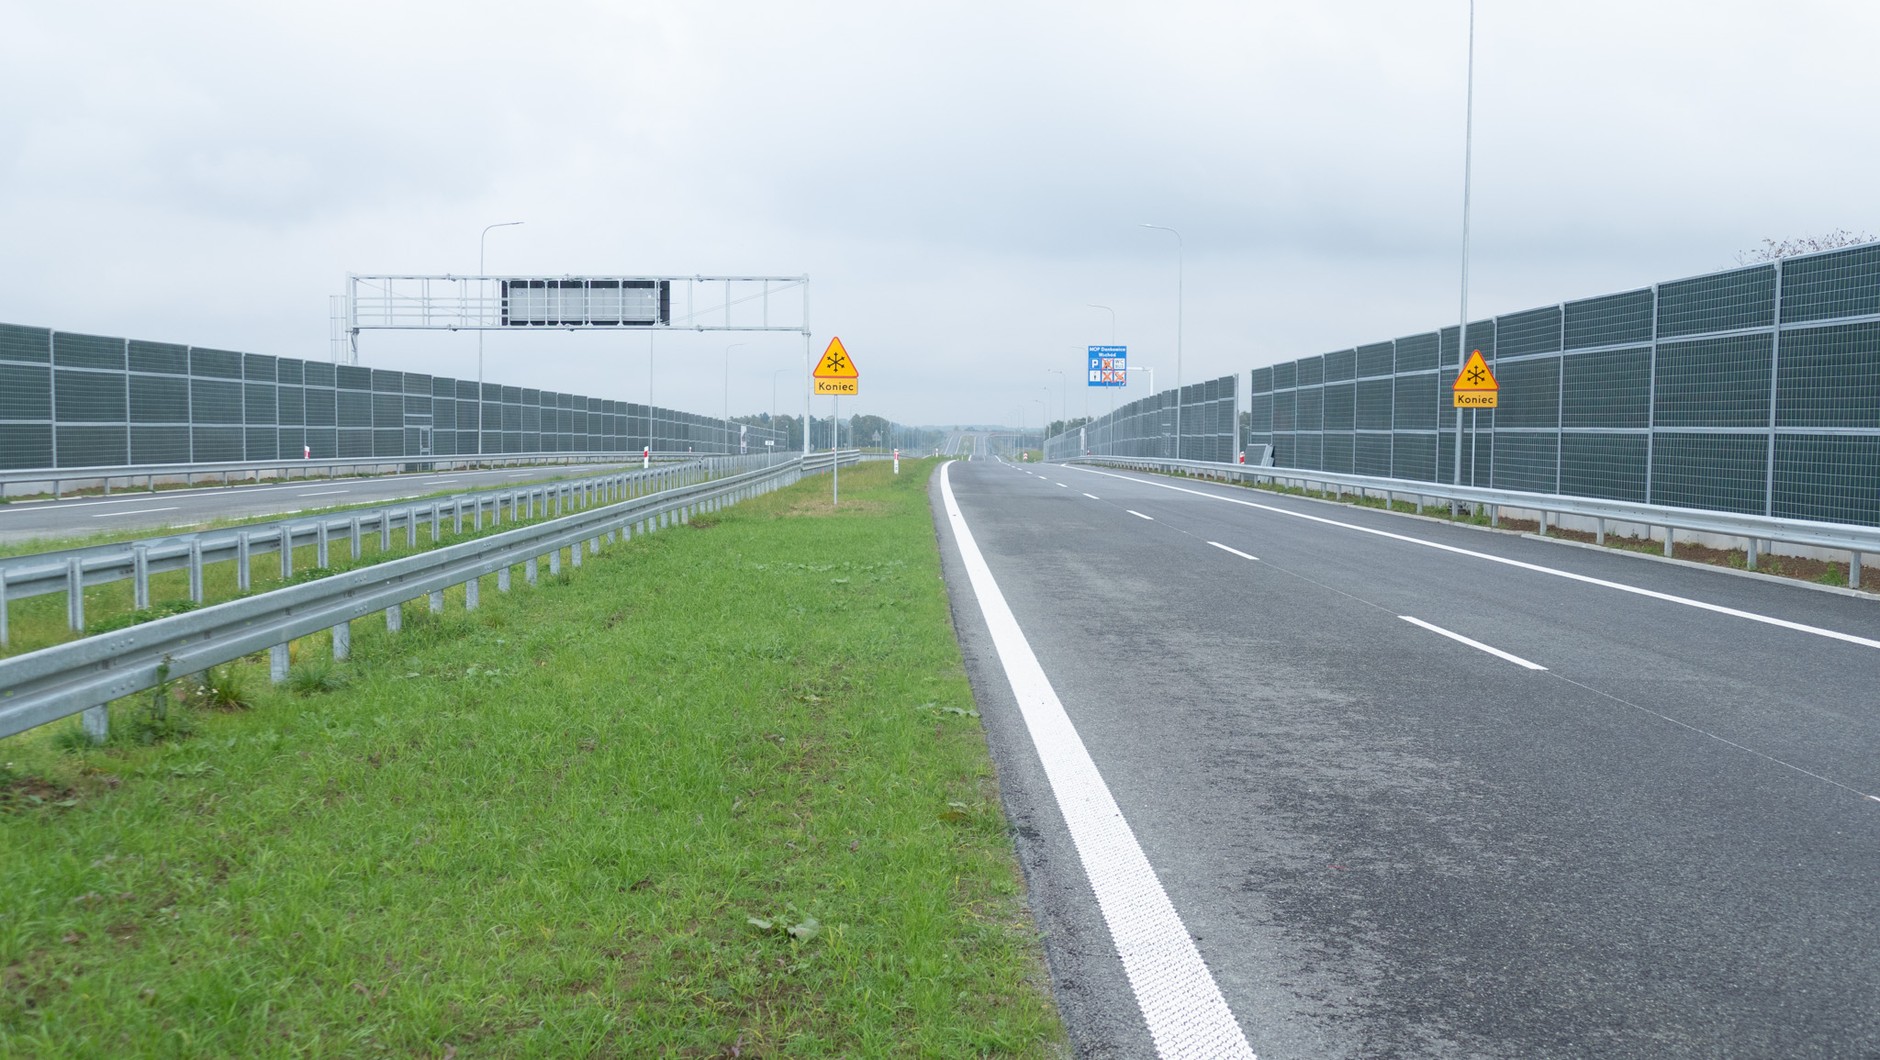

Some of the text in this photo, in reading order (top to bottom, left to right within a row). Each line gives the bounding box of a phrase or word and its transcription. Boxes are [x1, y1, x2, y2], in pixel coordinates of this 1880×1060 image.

[1091, 359, 1099, 368] P
[818, 381, 854, 391] Koniec
[1457, 394, 1494, 404] Koniec
